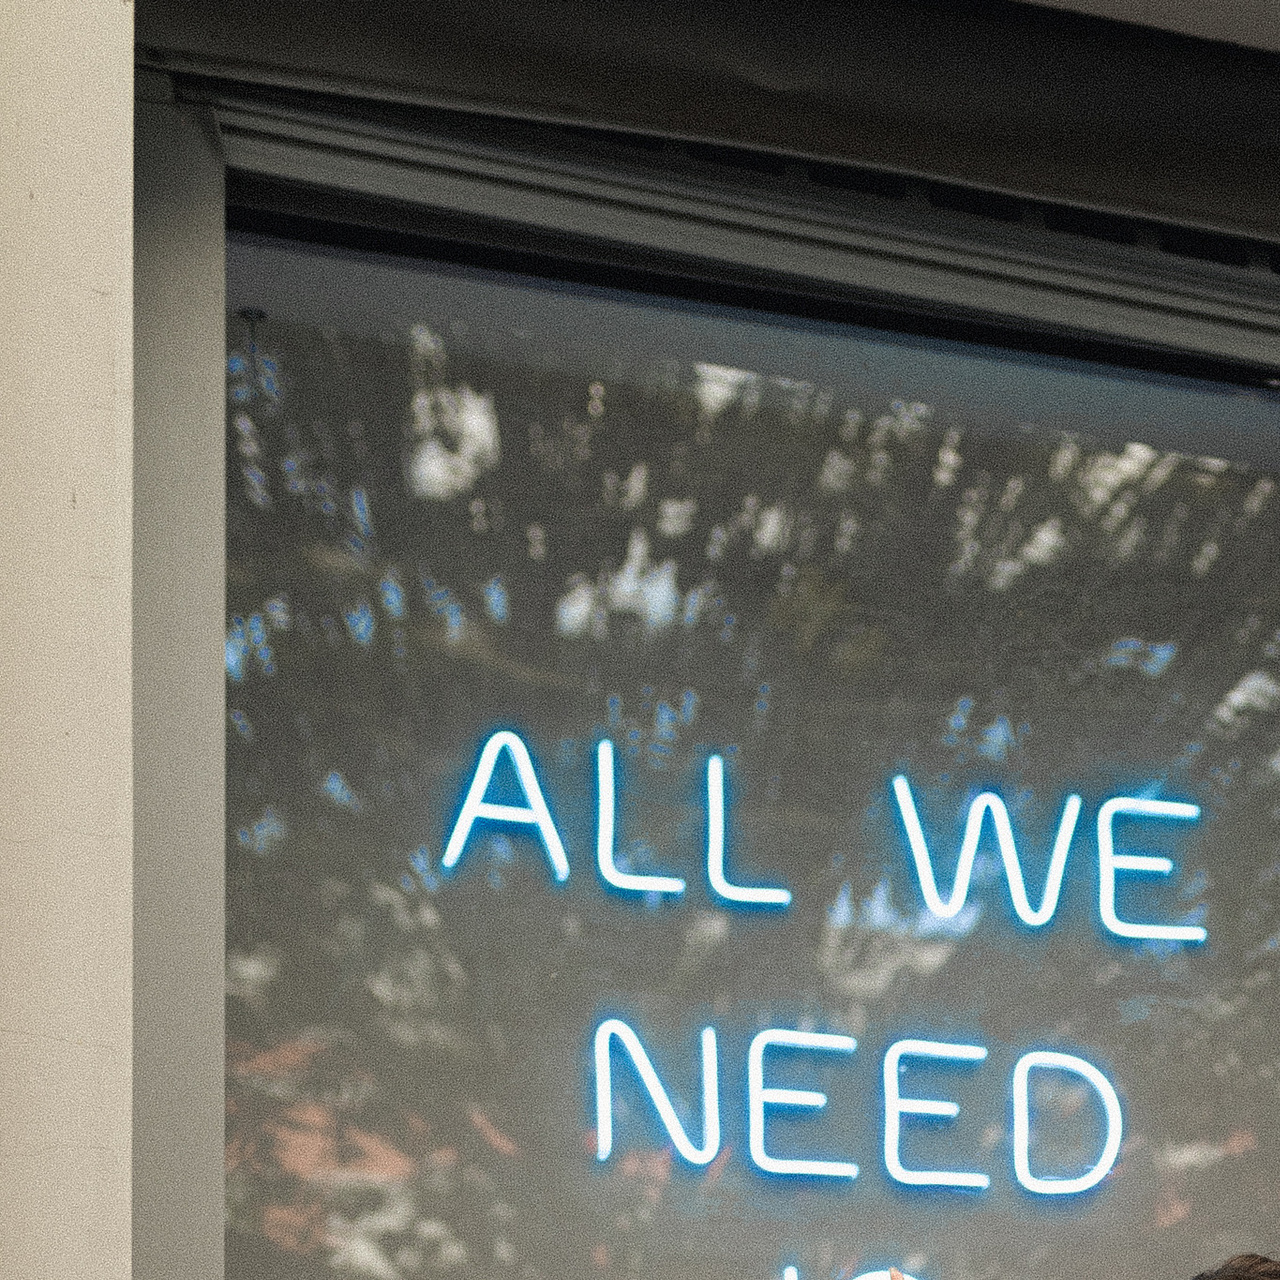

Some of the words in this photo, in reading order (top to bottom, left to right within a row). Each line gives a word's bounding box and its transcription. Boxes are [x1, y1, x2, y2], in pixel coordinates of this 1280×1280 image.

[442, 731, 792, 906] ALL
[891, 774, 1207, 942] WE
[594, 1018, 1123, 1195] NEED
